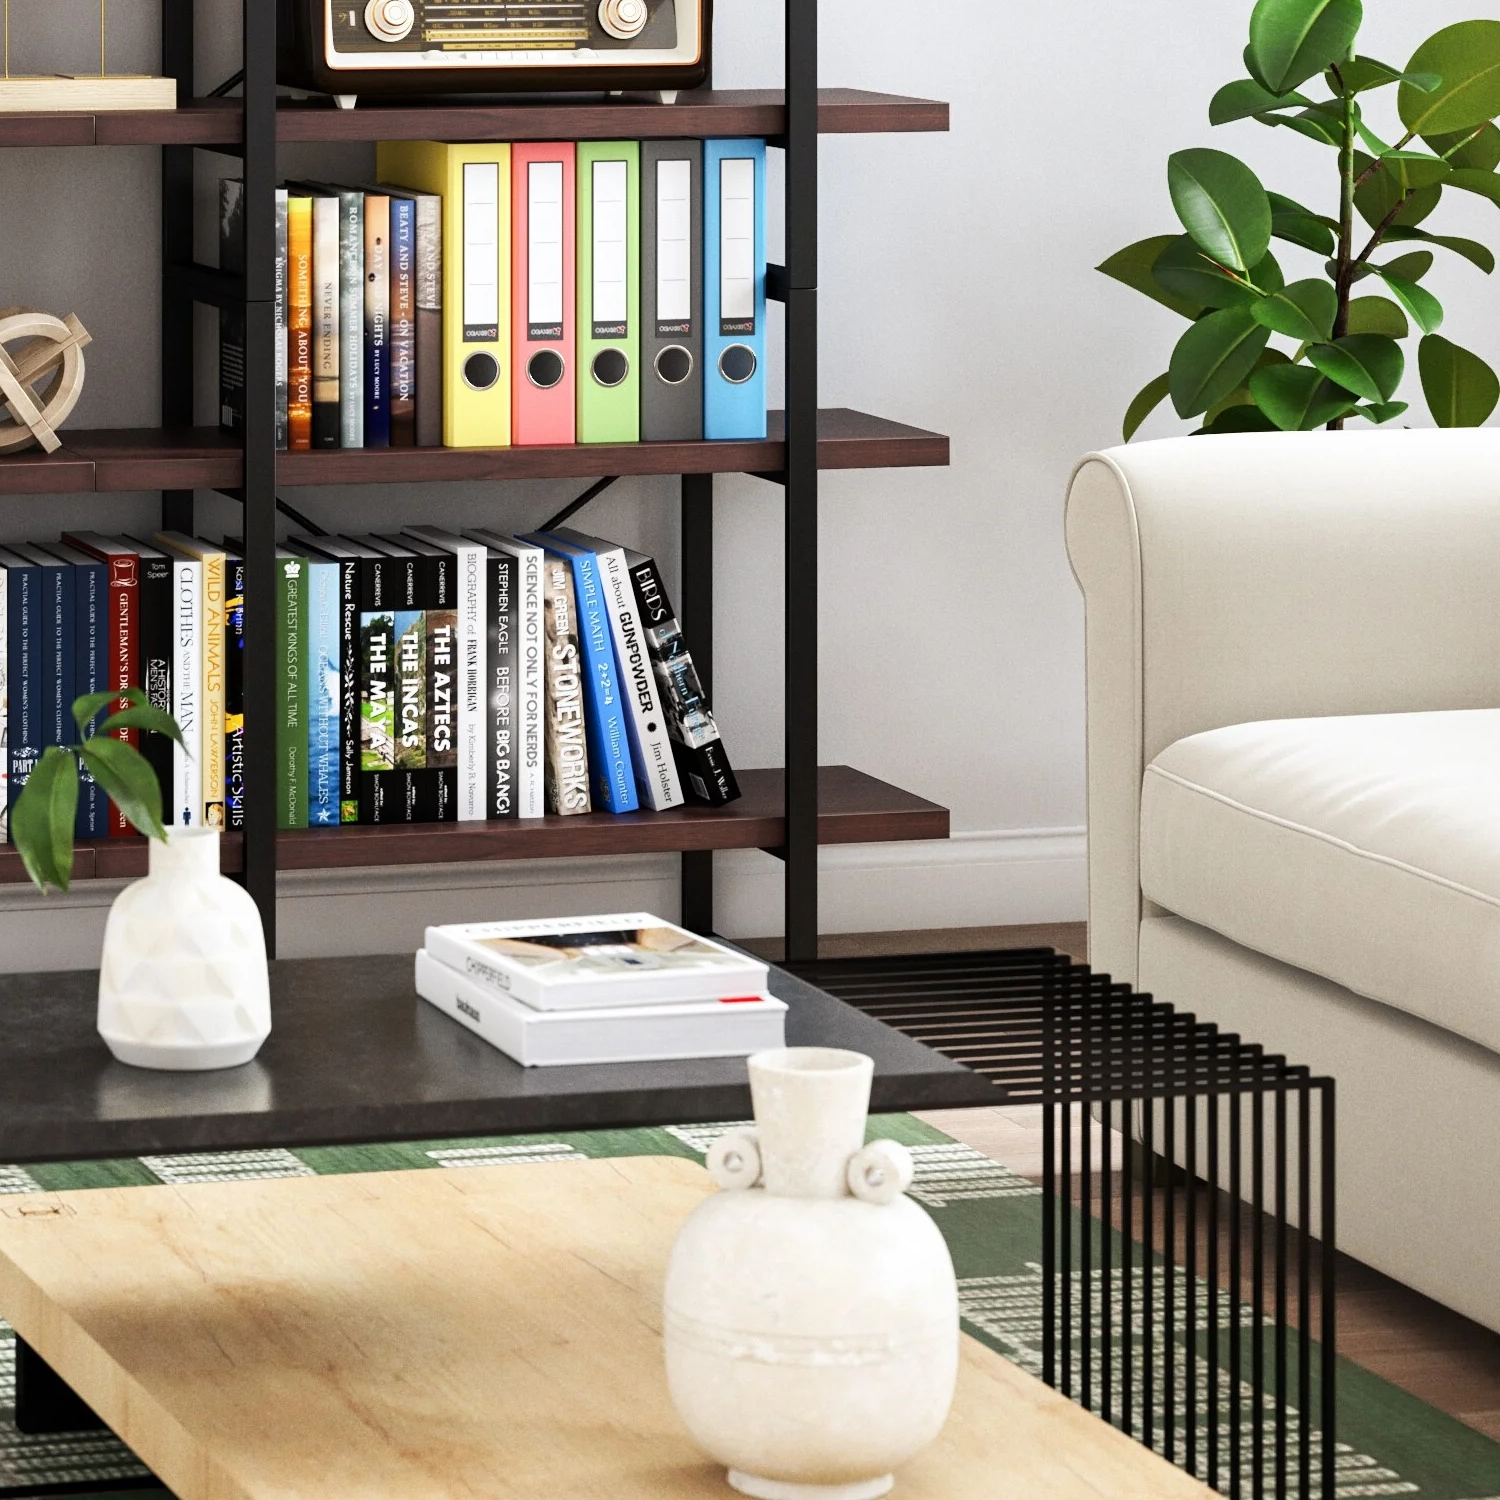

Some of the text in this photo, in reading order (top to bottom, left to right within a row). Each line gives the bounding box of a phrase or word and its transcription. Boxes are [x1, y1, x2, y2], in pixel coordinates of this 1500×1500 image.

[323, 282, 333, 369] NEVER ENDING
[398, 204, 410, 402] BEATY AND STEVE ON VACATION
[119, 592, 130, 673] GENTLEMAN'S
[206, 557, 221, 693] WILD ANIMALS
[343, 561, 355, 641] Nature Rescue
[498, 563, 509, 655] STEPHEN EAGLE
[551, 568, 570, 637] JIM GREEN
[578, 560, 606, 653] SIMPLE MATH
[635, 566, 669, 623] BIRDS
[286, 579, 299, 729] GREATEST KINGS OF ALL TIME
[369, 632, 386, 751] THE MAYA
[401, 631, 419, 748] THE INCAS
[433, 625, 451, 752] THE AZTECS
[526, 555, 538, 768] SCIENCE NOT ONLY FOR NERDS
[618, 610, 655, 715] GUNPOWDER
[496, 666, 510, 815] BEFORE BIG BANG!
[552, 642, 588, 810] STONEWORKS
[649, 740, 673, 804] Jim Holster
